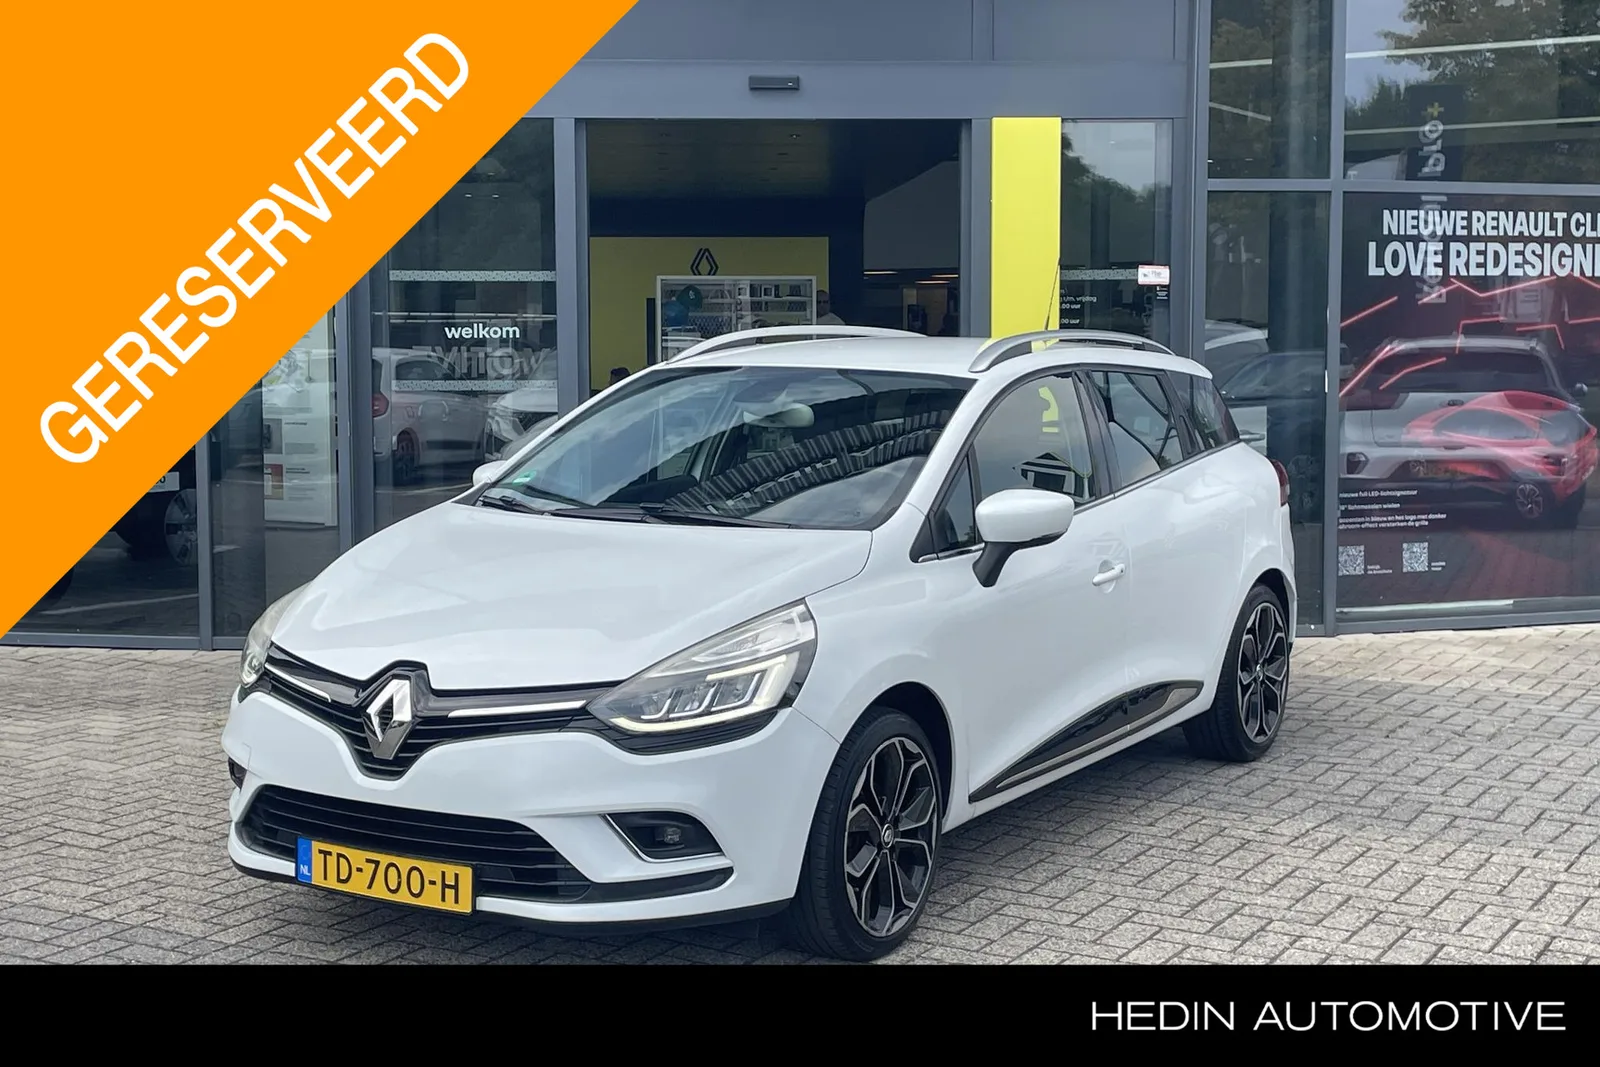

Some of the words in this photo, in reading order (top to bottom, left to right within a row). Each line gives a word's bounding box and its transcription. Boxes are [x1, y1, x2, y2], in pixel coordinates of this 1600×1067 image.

[1383, 209, 1468, 237] NIEUWE
[1471, 211, 1567, 238] RENAULT
[1367, 241, 1444, 277] LOVE
[444, 322, 521, 339] welkom
[300, 864, 312, 876] NL
[318, 848, 460, 905] TD-700-H
